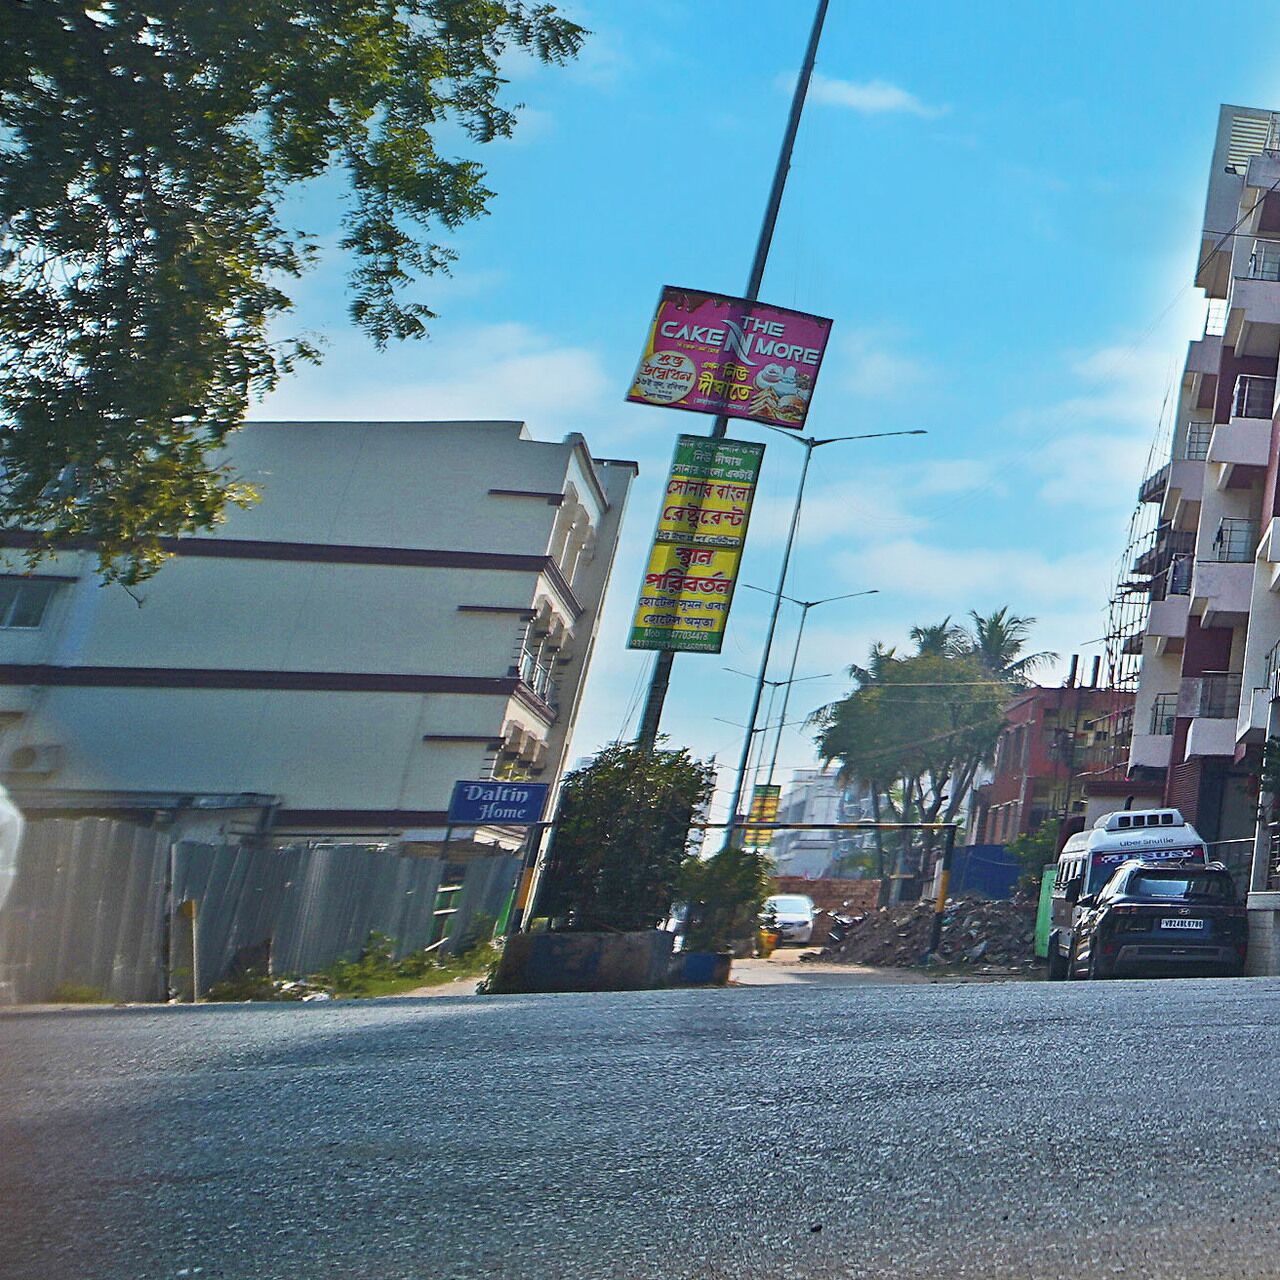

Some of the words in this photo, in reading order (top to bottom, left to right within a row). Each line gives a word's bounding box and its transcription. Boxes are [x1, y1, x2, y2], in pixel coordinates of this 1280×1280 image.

[741, 315, 785, 337] THE
[660, 321, 726, 348] CAKE
[755, 337, 820, 366] MORE
[667, 480, 715, 499] সোনার
[716, 484, 754, 502] বাংলা
[645, 568, 732, 595] পরিবর্তন
[464, 785, 529, 804] Daltin
[475, 801, 527, 820] Home
